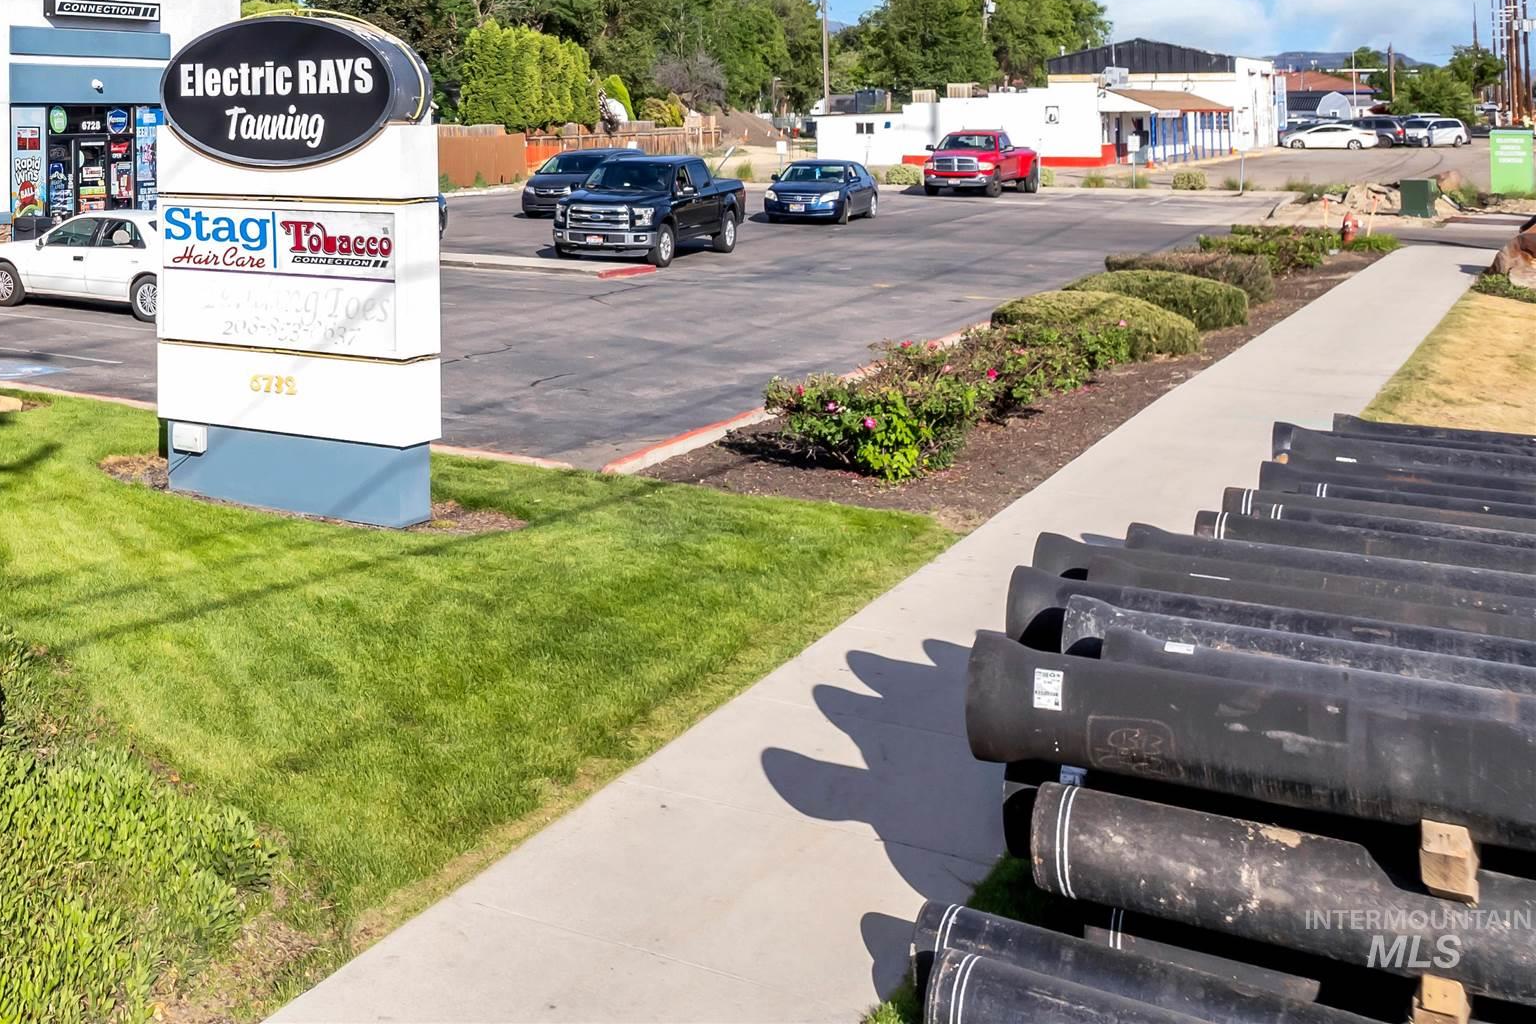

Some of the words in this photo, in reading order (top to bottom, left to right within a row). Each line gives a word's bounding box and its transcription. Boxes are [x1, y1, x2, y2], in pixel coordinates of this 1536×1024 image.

[63, 3, 136, 15] CONNECTION
[179, 61, 293, 97] Electric
[297, 57, 374, 95] RAYS
[81, 120, 101, 130] 6728
[225, 105, 326, 149] Tanning
[14, 157, 41, 172] Rapid
[15, 170, 40, 185] Wins
[20, 187, 35, 199] BALL
[164, 207, 271, 251] Stag
[172, 244, 219, 266] Hair
[222, 246, 266, 269] Care
[293, 256, 370, 268] CONNECTION
[325, 287, 390, 323] Toes
